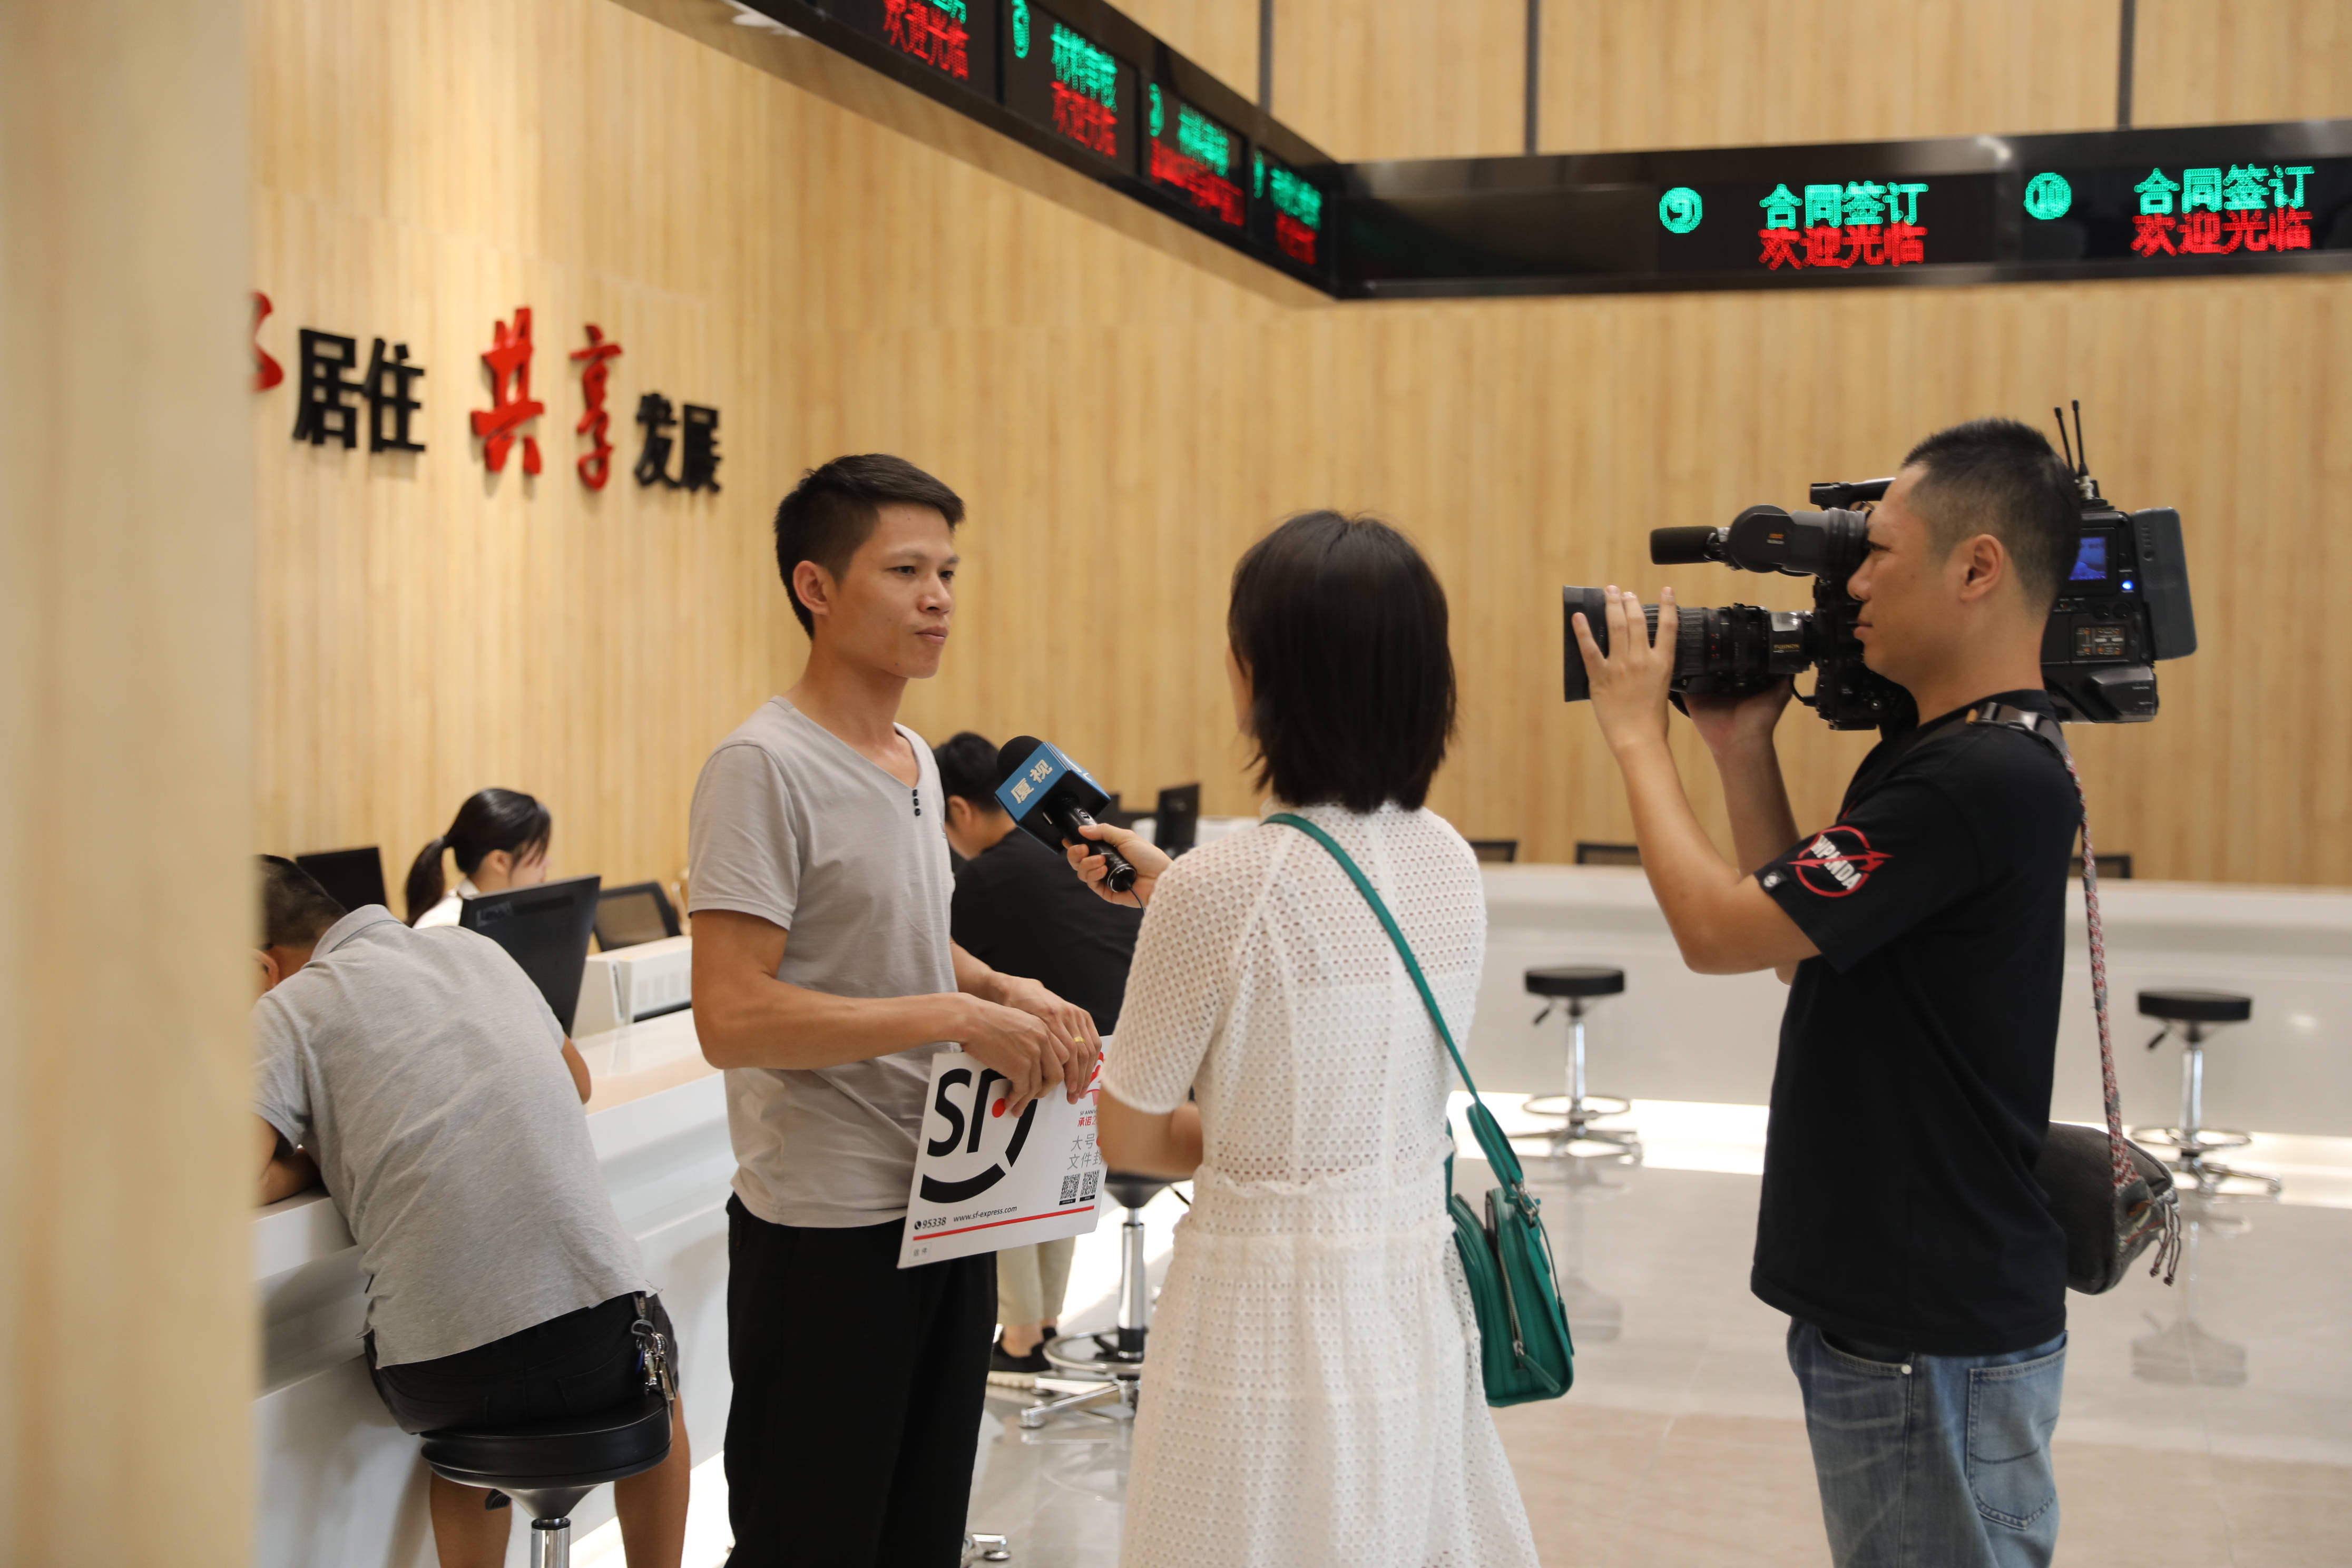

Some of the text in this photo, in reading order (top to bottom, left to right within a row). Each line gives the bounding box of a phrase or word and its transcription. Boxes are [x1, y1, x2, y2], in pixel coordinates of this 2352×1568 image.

[1759, 181, 1929, 230] 合同签订
[2134, 164, 2315, 215] 合同签订
[1758, 220, 1928, 270] 欢迎光临
[2131, 206, 2313, 258] 欢迎光临
[293, 327, 426, 454] 居住
[634, 393, 722, 493] 发展
[1011, 759, 1053, 804] 厦视
[1067, 1151, 1103, 1170] 文件封
[1071, 1133, 1095, 1151] 大号
[922, 1206, 1017, 1229] 95338 www.sf-express.com
